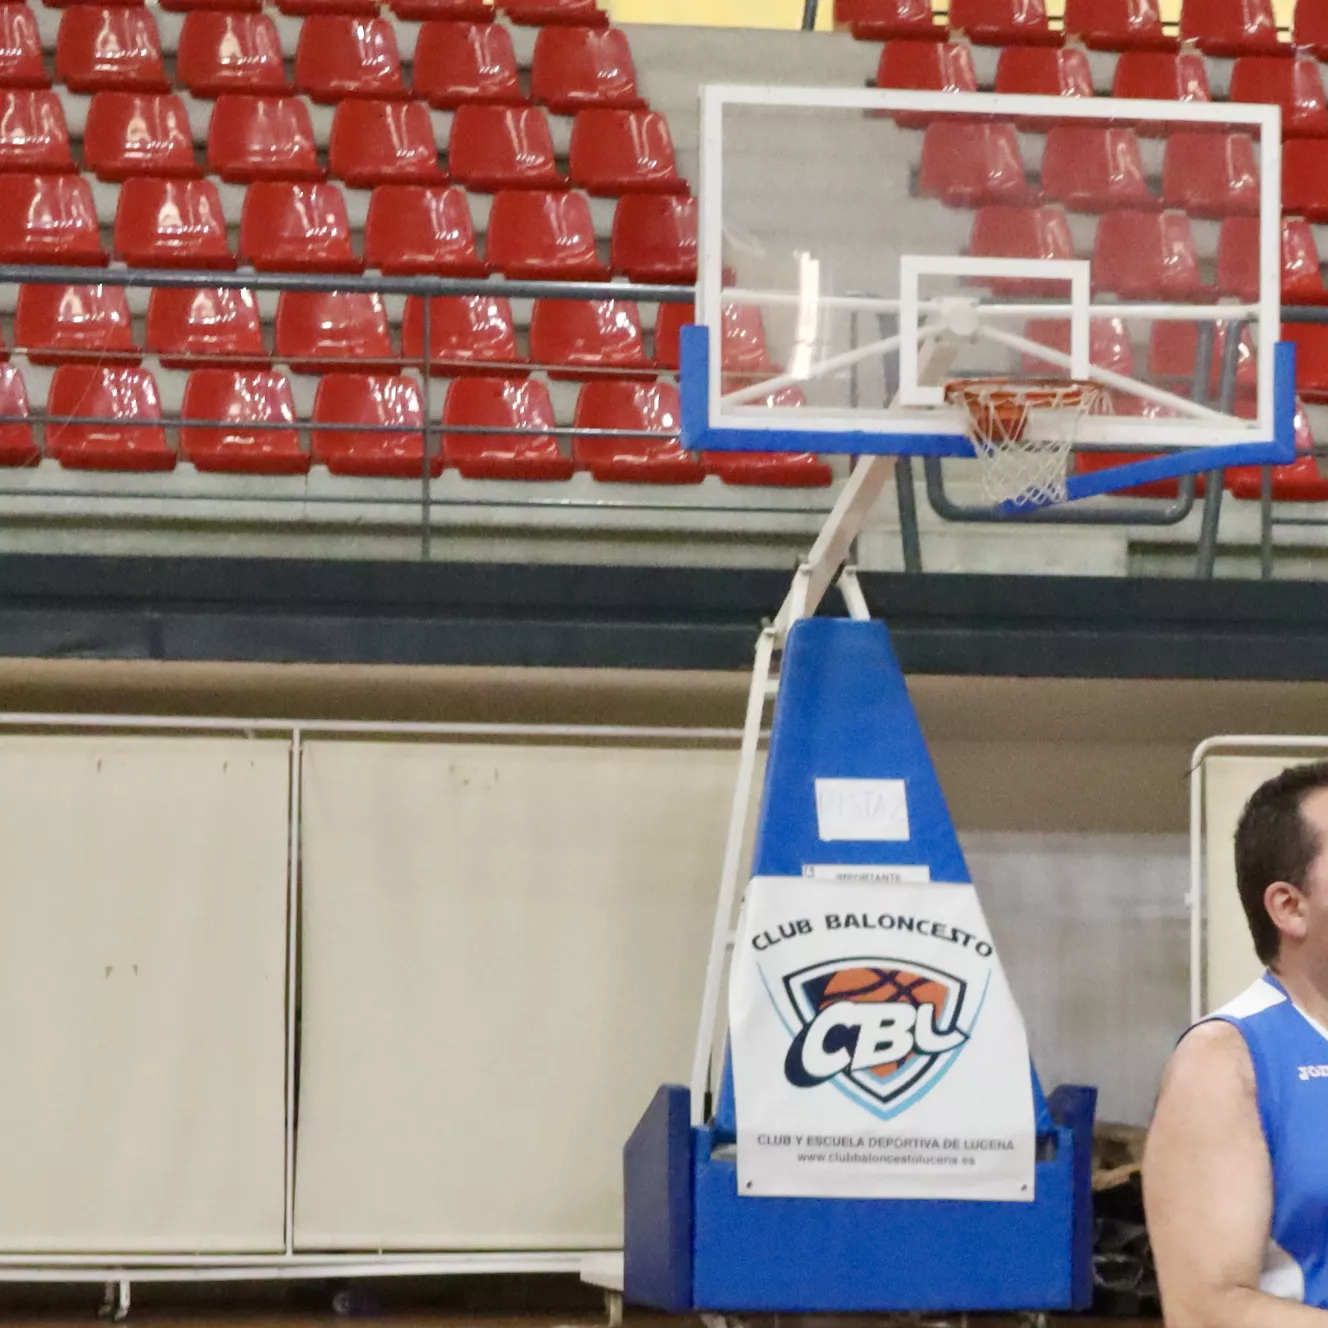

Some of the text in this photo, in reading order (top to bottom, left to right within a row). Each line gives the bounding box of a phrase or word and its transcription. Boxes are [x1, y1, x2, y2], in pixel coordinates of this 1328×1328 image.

[752, 913, 993, 958] CLUB BALONCESTO
[757, 1134, 1014, 1151] CLUB Y ESCUELA DEPORTIVA DE LUCENA
